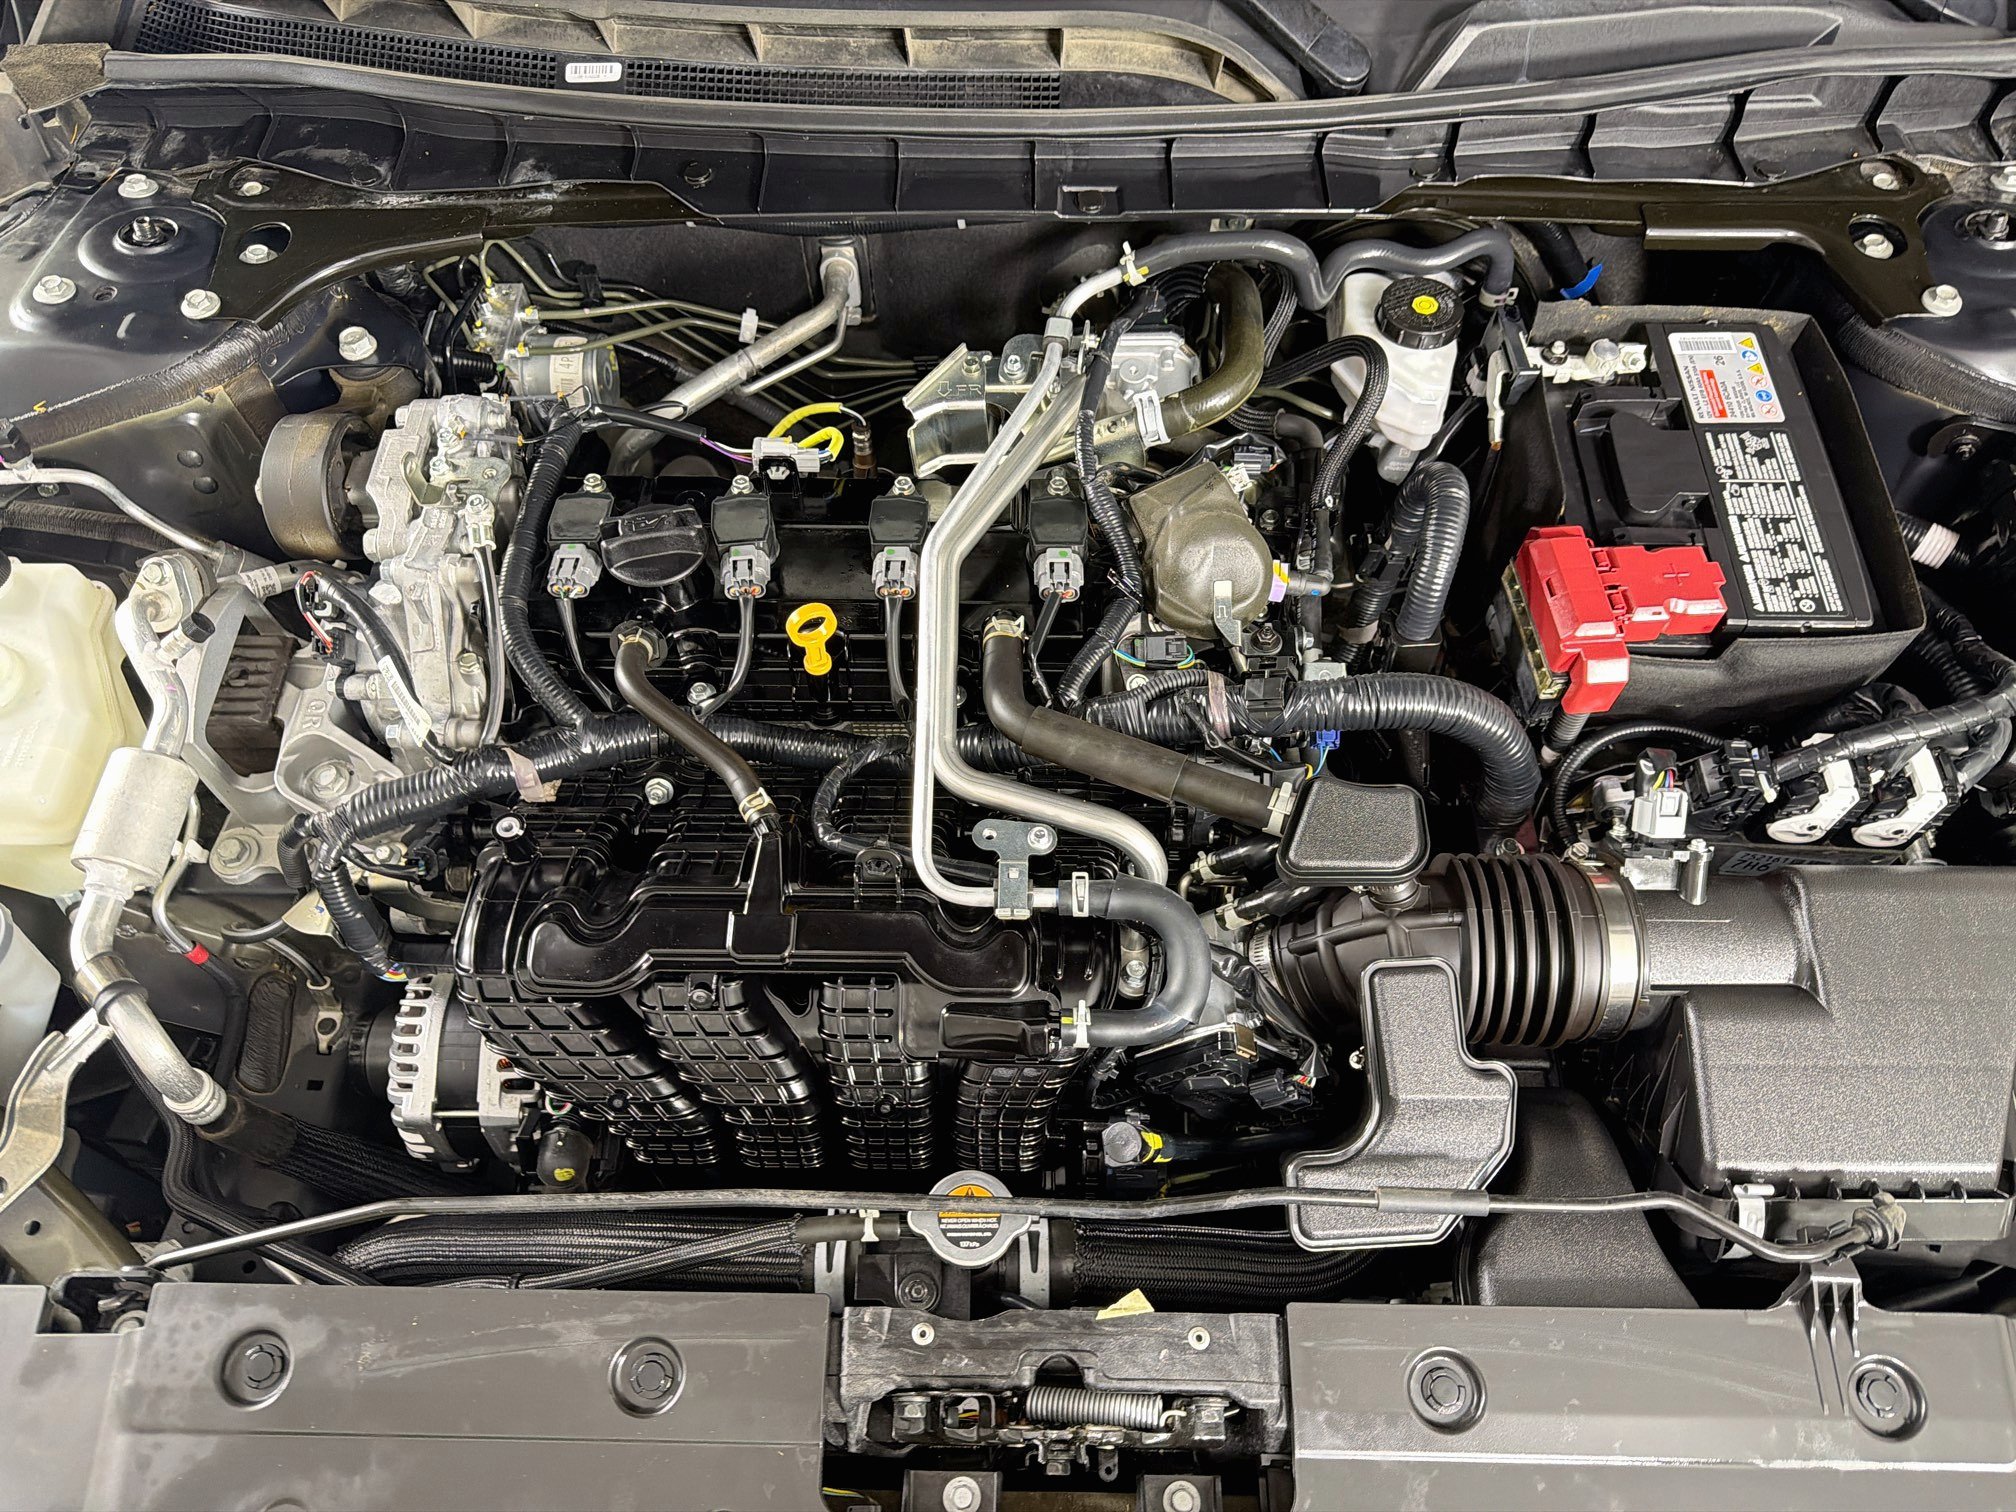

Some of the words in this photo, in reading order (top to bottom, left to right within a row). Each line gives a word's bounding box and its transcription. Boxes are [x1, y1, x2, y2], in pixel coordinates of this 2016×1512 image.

[1713, 355, 1726, 366] 26
[1683, 365, 1695, 391] NISSAN
[956, 384, 982, 396] FR
[1692, 393, 1704, 418] RENAULT
[1731, 859, 1770, 871] 7H6
